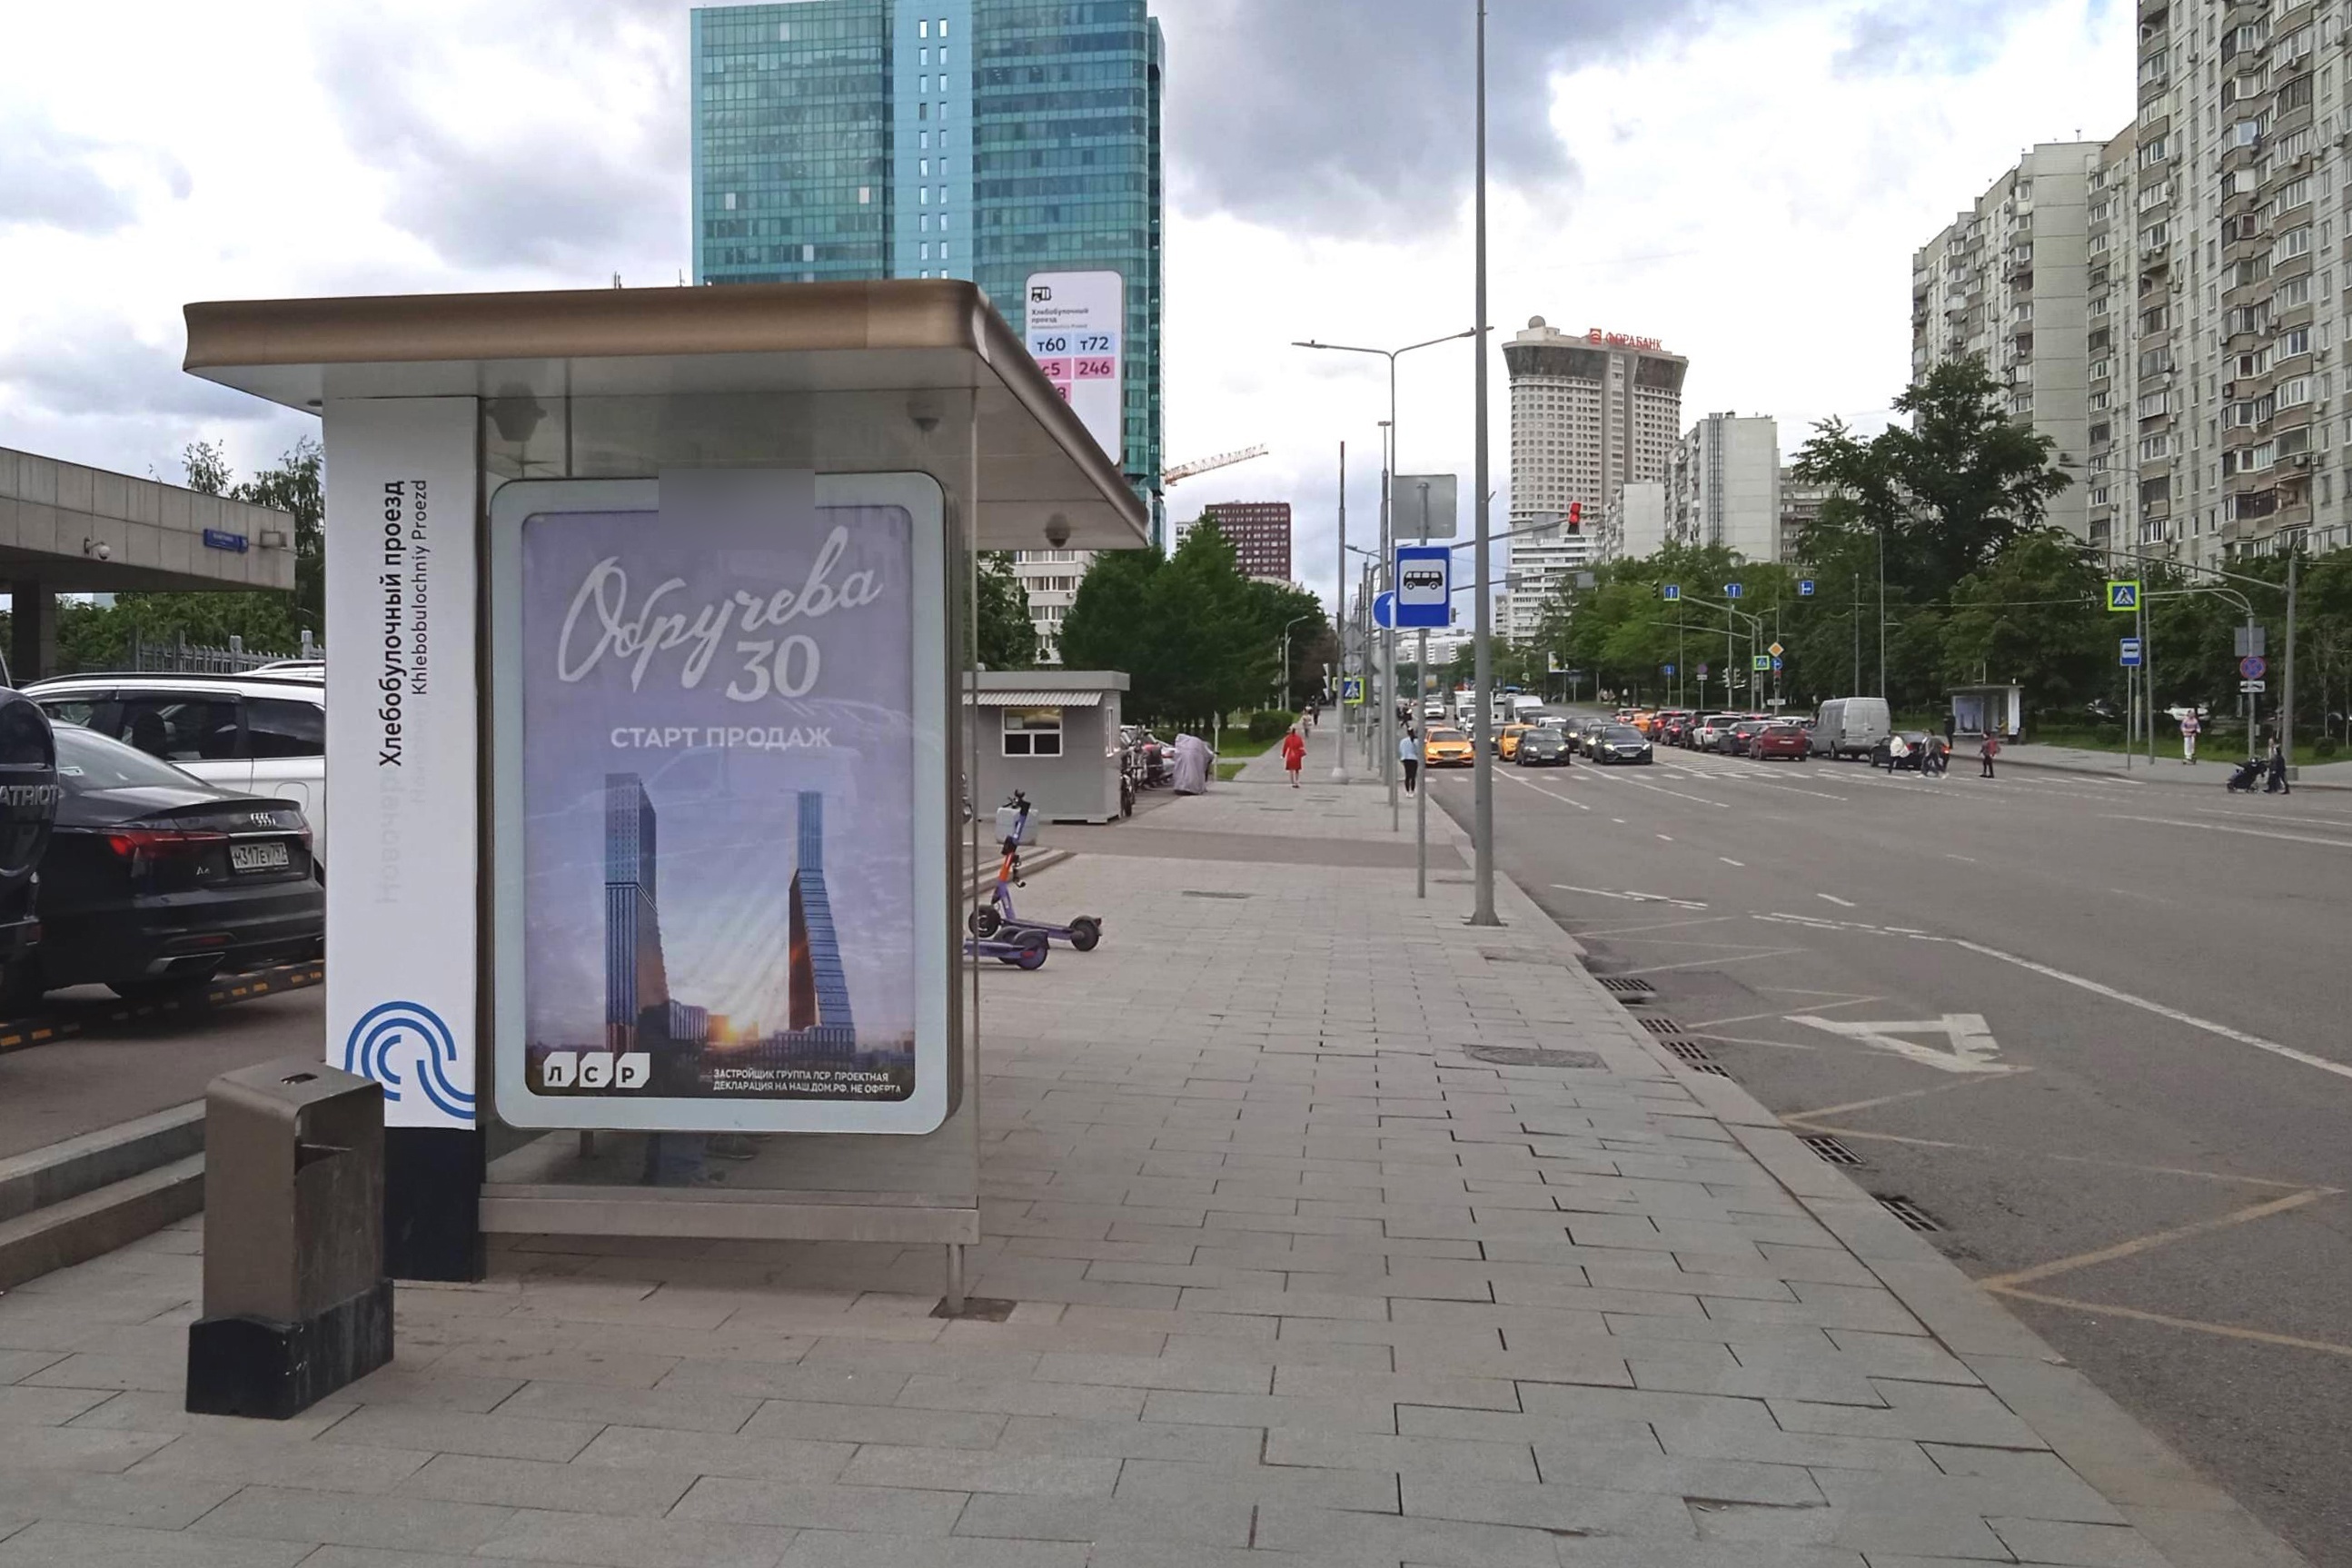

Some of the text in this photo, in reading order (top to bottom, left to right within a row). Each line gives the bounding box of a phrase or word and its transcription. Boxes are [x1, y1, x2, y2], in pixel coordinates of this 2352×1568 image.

[1605, 332, 1663, 352] ФОРАБАНК
[1079, 362, 1110, 375] 246
[411, 480, 427, 540] Proezd
[411, 546, 431, 694] Khlebobulochniy
[558, 525, 883, 693] Обручева
[378, 481, 407, 766] Хлебобулочный проезд
[726, 635, 821, 702] 30
[610, 727, 832, 751] СТАРТ ПРОДАЖ
[548, 1066, 635, 1083] ЛСР
[713, 1067, 889, 1081] ЗАСТРОЙЩИК ГРУППА ЛСР. ПРОЕКТНАЯ
[713, 1080, 774, 1091] ДЕКЛАРАЦИЯ
[775, 1082, 788, 1091] НА
[850, 1084, 863, 1093] НЕ
[864, 1085, 901, 1094] ОФЕРТА
